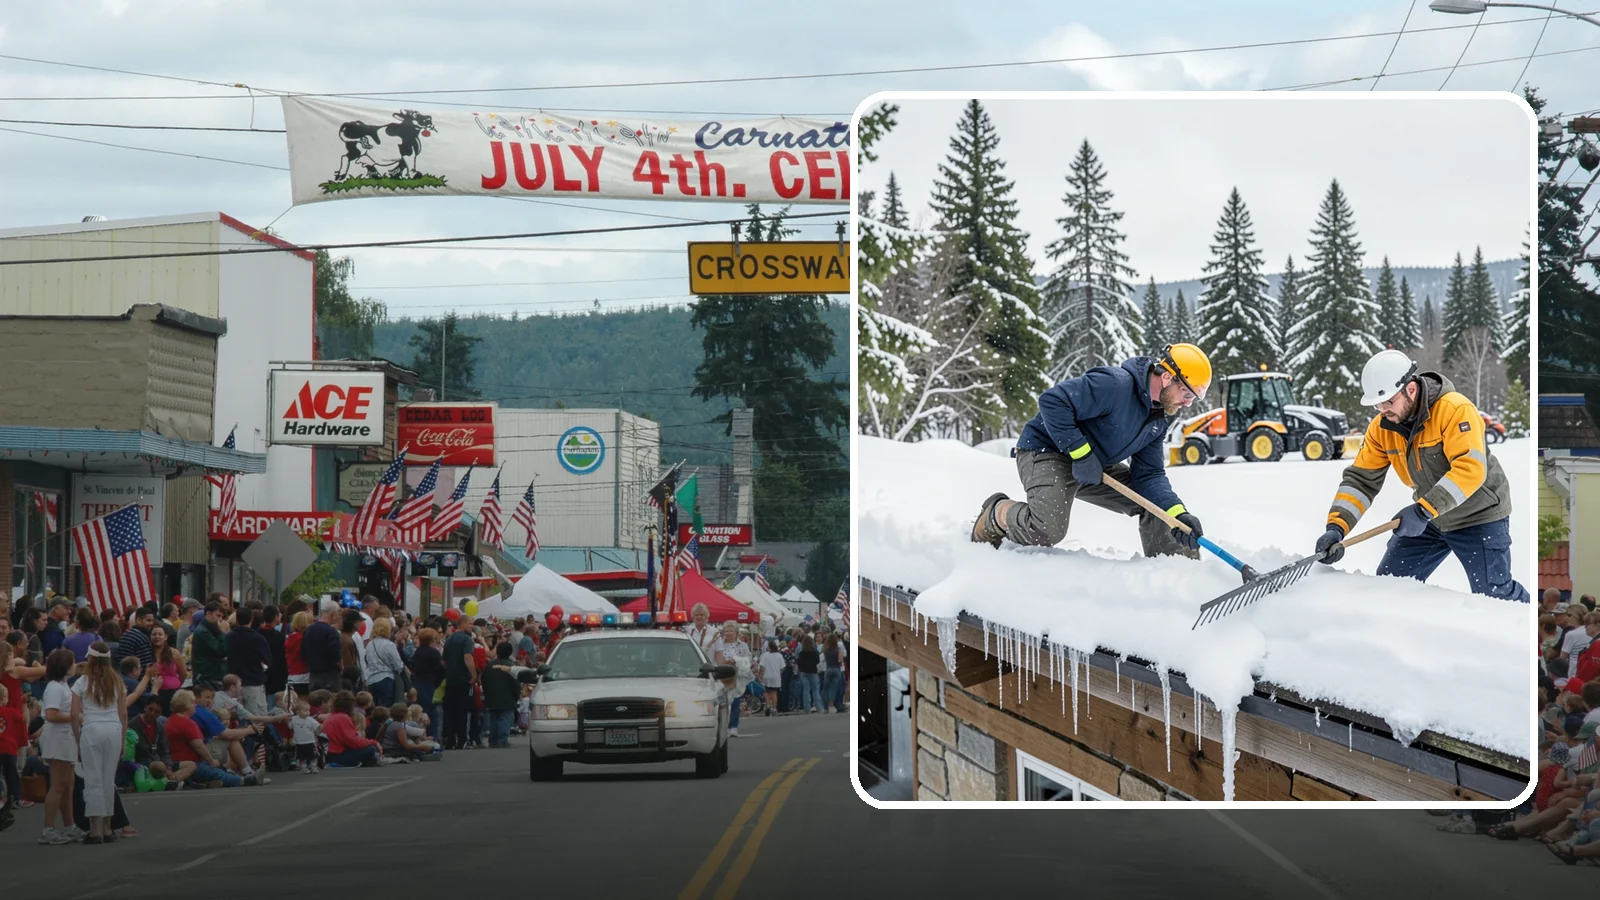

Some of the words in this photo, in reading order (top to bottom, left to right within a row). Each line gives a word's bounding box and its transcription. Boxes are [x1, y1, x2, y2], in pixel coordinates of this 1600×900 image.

[695, 121, 850, 150] Carnat
[481, 141, 604, 193] JULY
[632, 150, 746, 197] 4th.
[697, 254, 850, 280] CROSSWA
[282, 380, 373, 419] ACE
[405, 408, 453, 421] CEDAR
[283, 421, 370, 436] Hardware
[416, 428, 476, 446] Coca-Cola
[353, 467, 386, 479] Simpl
[95, 485, 124, 494] Vincent
[126, 486, 136, 494] de
[137, 486, 155, 495] Paul
[688, 526, 741, 535] CRNATION
[699, 535, 730, 543] GLASS
